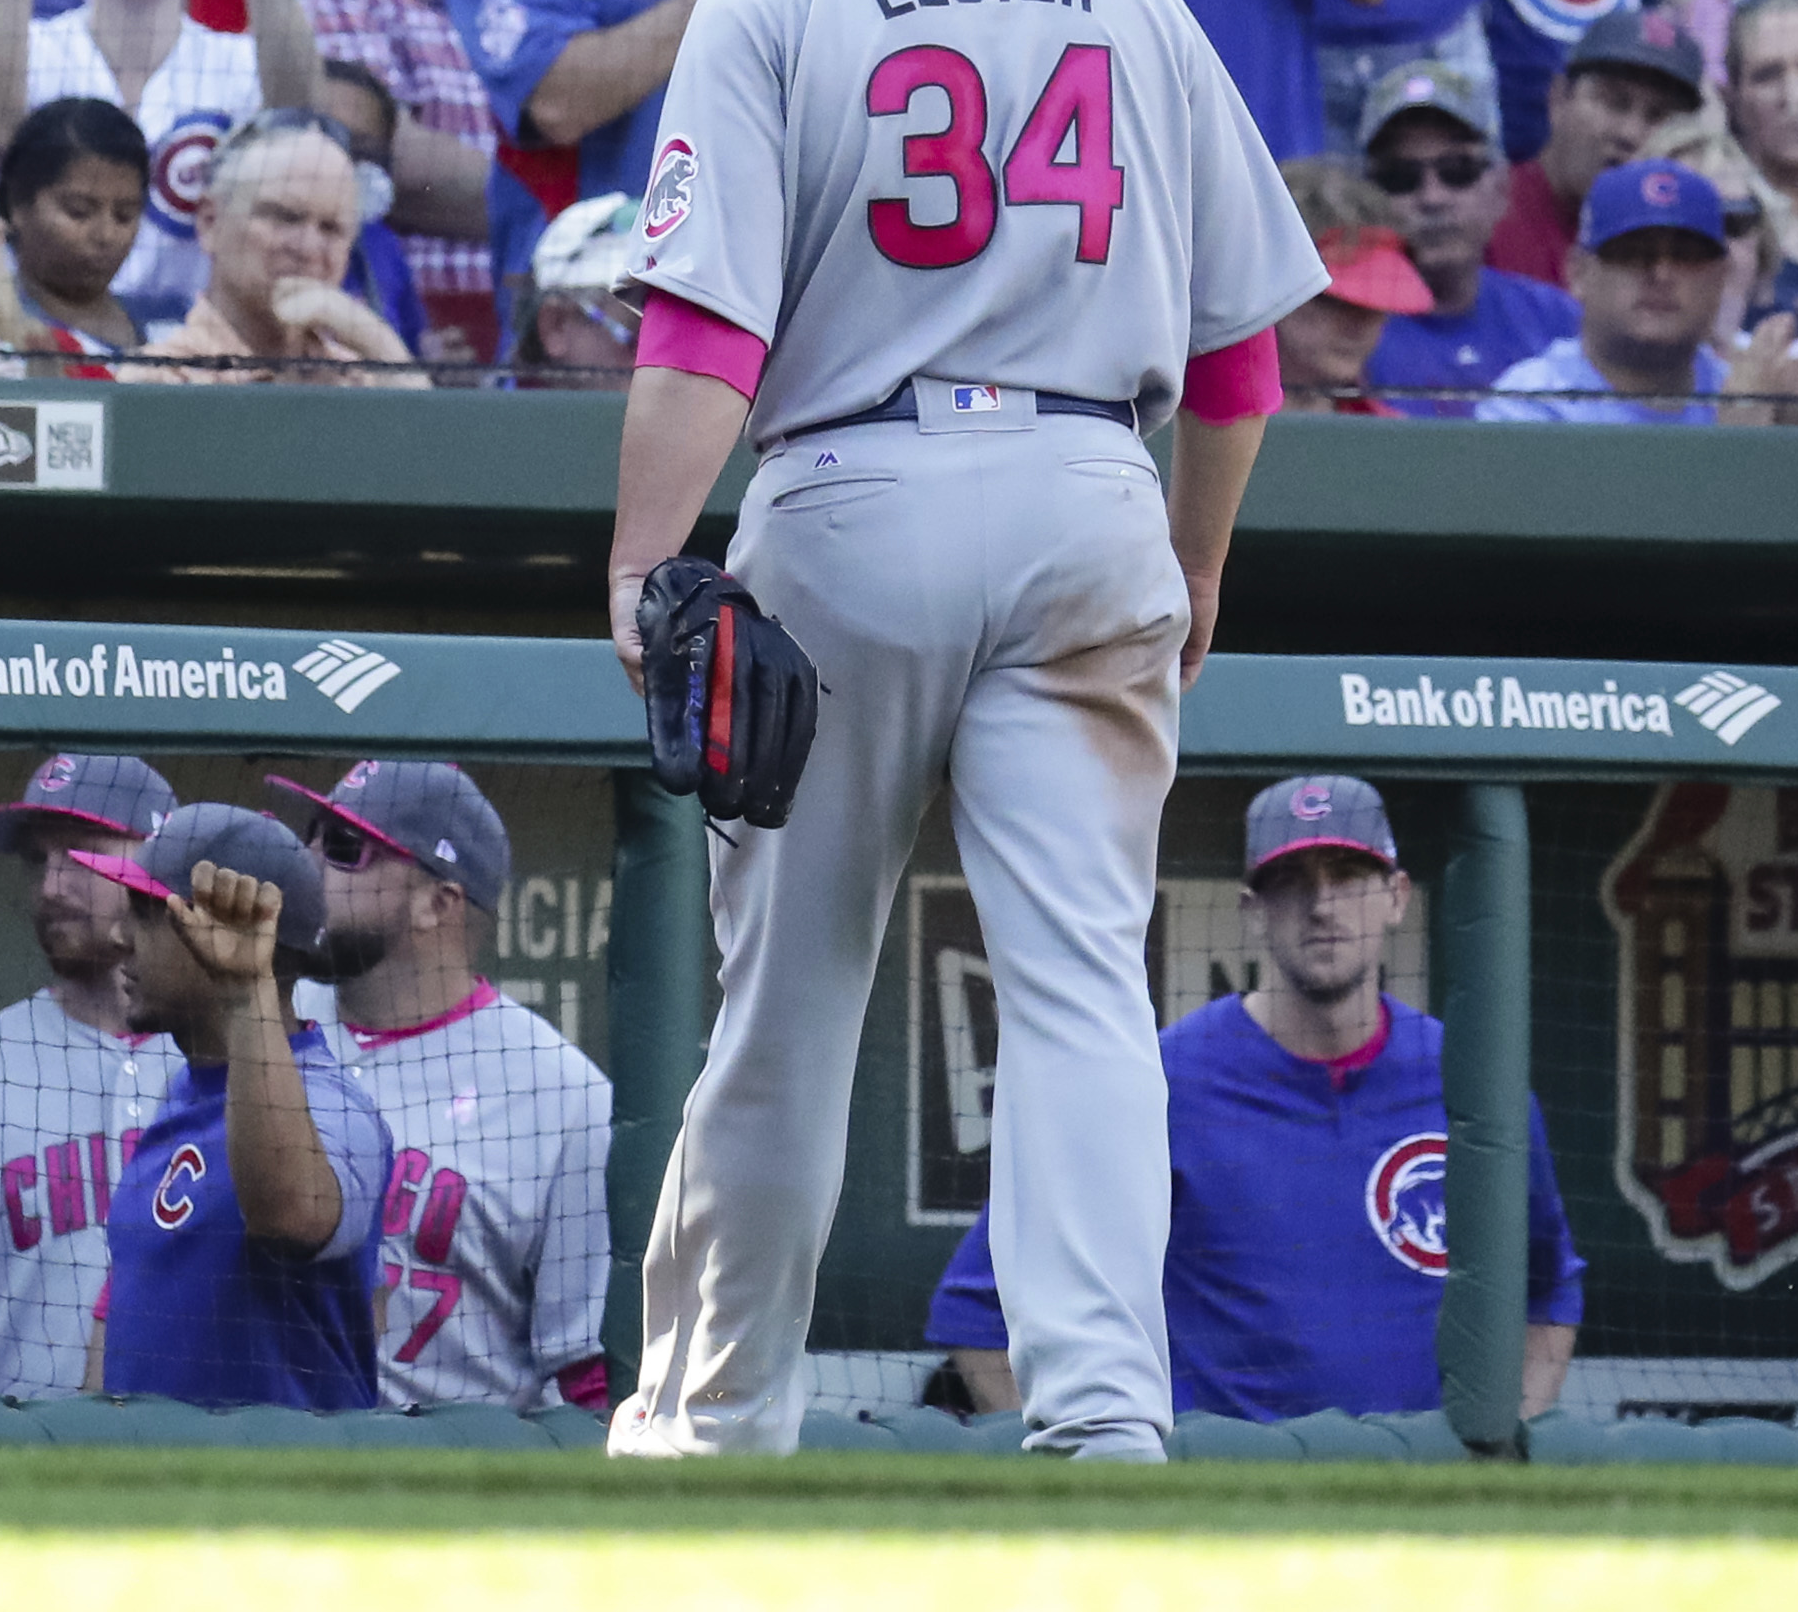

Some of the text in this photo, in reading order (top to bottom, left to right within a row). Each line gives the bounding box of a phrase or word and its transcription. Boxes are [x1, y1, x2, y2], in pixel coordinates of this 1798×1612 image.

[866, 43, 1124, 269] 34
[65, 643, 107, 697] of
[114, 645, 288, 701] America
[1341, 673, 1674, 737] Bank of America
[152, 1143, 207, 1230] C
